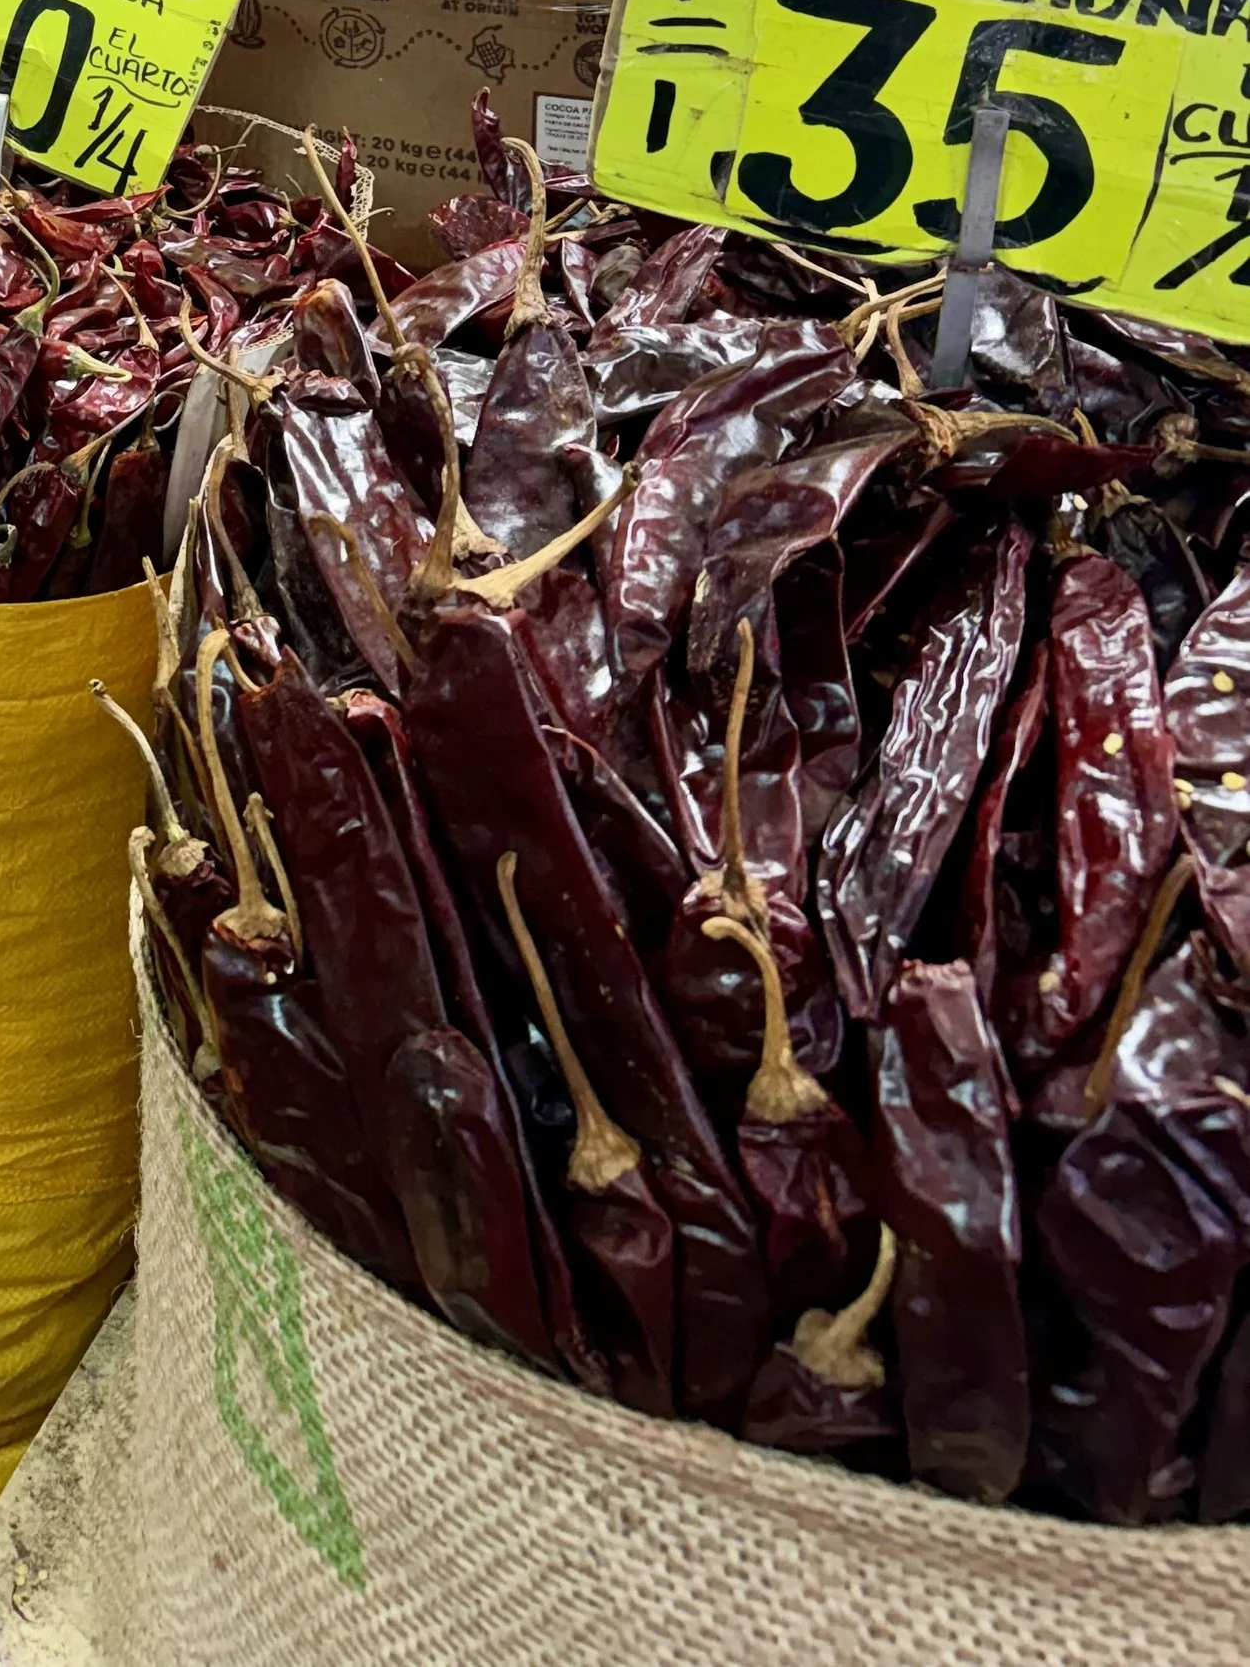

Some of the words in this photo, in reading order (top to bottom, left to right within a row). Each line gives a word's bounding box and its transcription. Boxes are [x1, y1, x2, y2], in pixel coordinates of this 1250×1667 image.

[441, 0, 459, 12] AT
[462, 1, 520, 18] ORIGIN
[109, 26, 138, 59] EL
[88, 45, 190, 97] CUARTO
[544, 103, 580, 113] COCOA
[74, 85, 148, 196] 1/4
[371, 136, 395, 152] 20
[366, 154, 390, 170] 20
